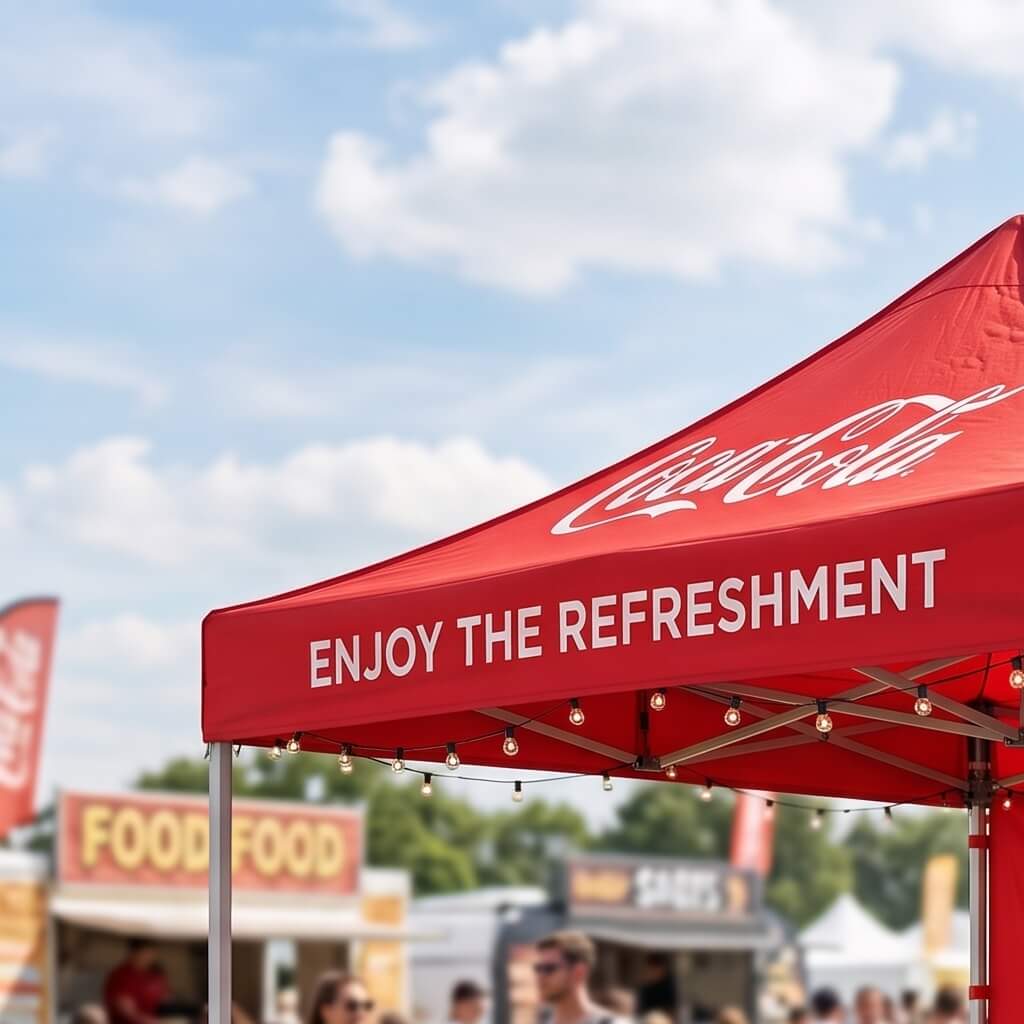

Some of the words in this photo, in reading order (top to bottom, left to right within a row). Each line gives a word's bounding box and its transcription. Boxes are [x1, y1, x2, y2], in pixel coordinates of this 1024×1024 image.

[310, 621, 443, 689] ENJOY
[457, 605, 542, 667] THE
[559, 549, 946, 653] REFRESHMENT
[81, 803, 209, 871] FOOD
[232, 815, 345, 877] FOOD
